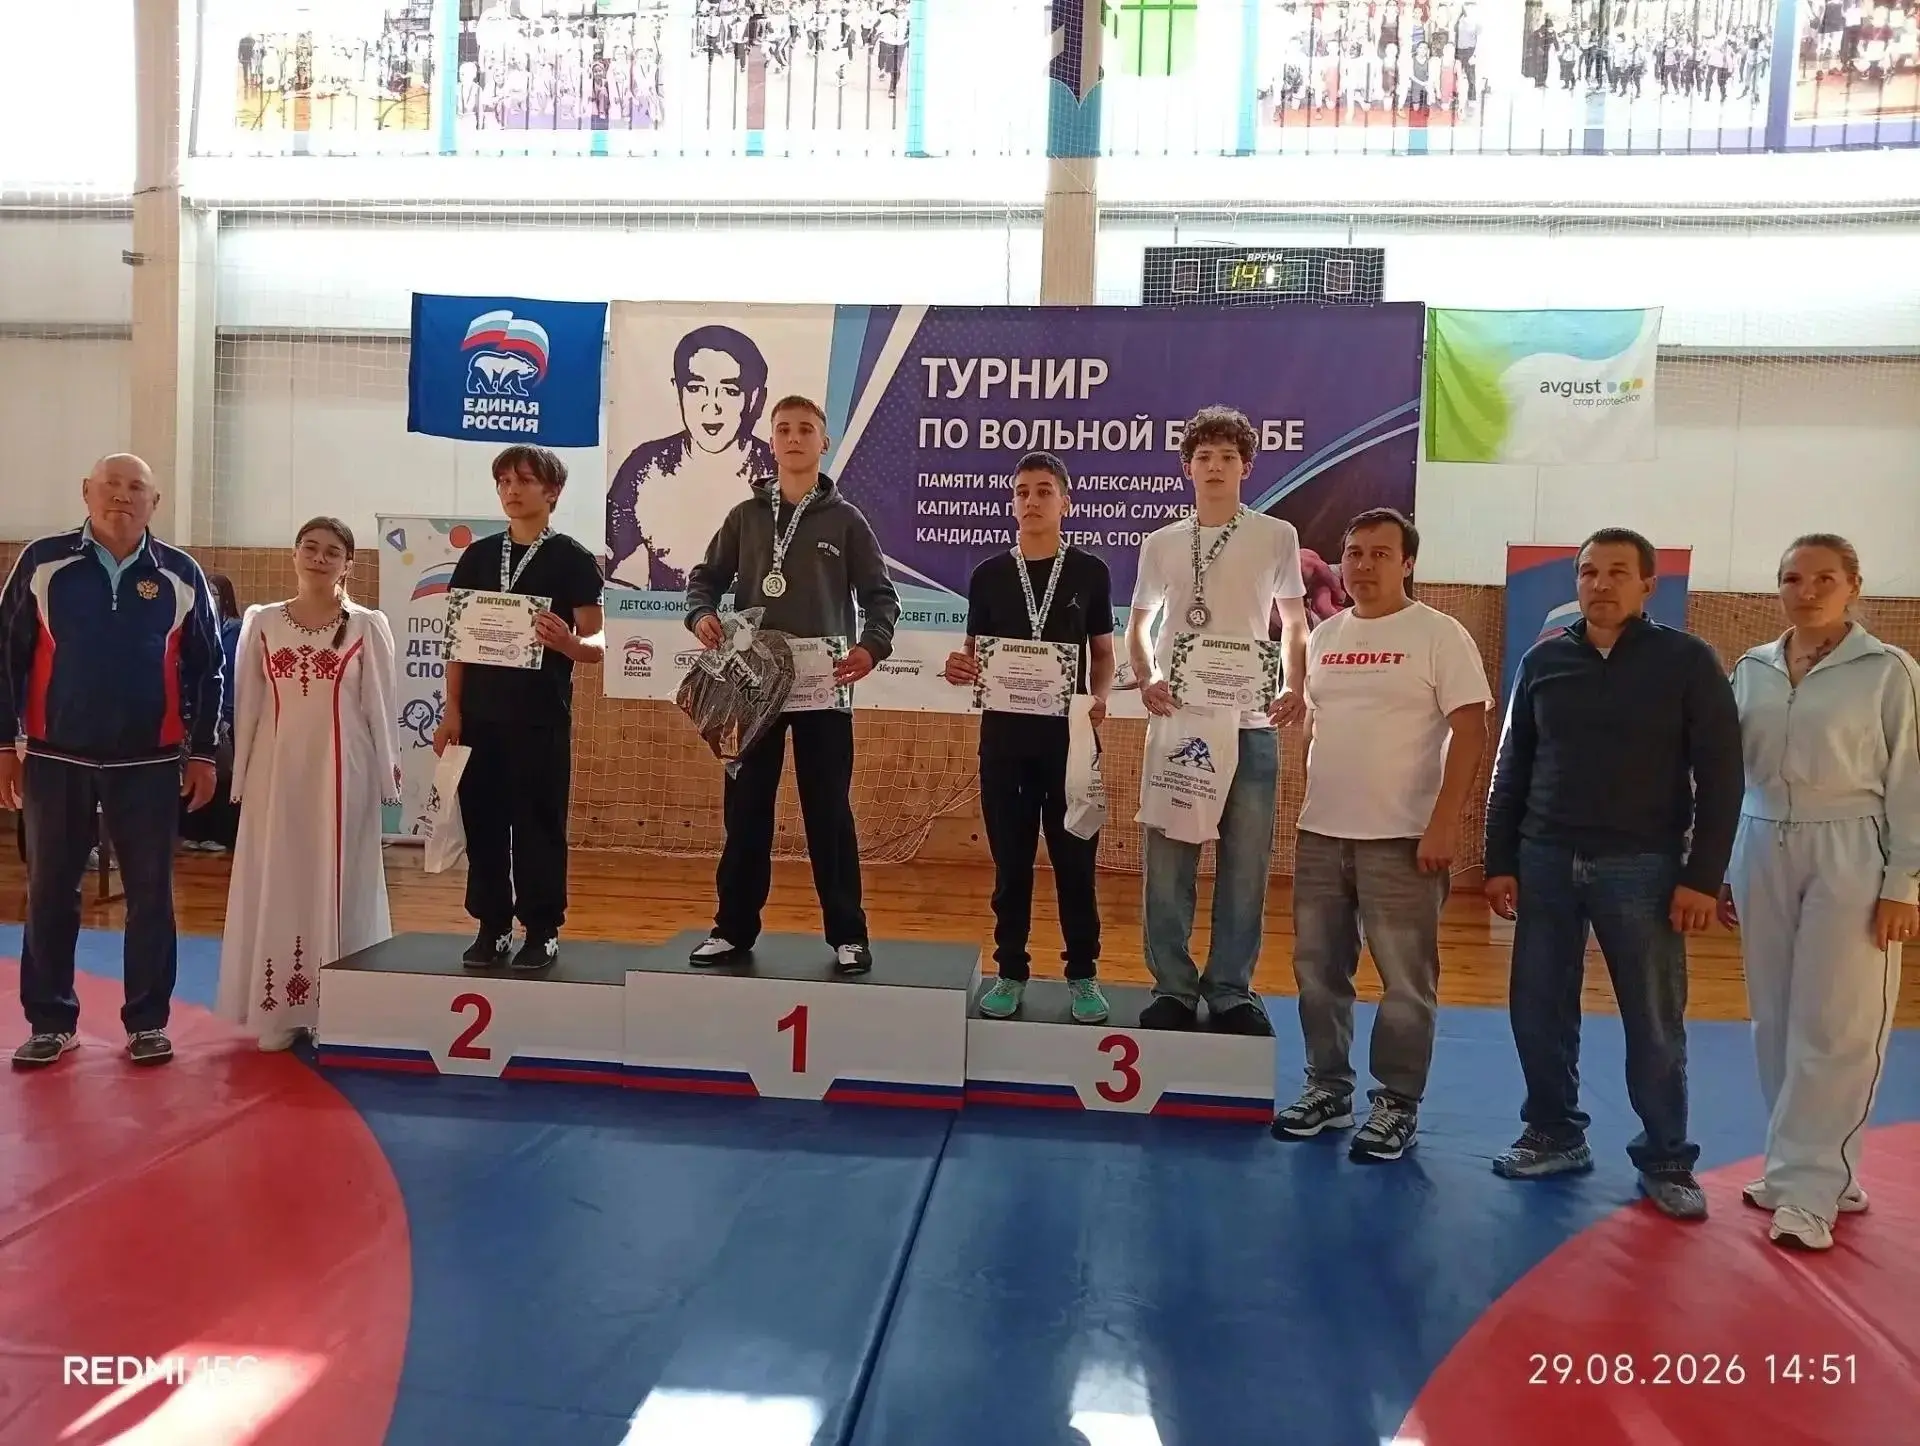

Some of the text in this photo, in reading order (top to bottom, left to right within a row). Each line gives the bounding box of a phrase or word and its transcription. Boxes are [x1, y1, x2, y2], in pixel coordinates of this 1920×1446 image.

[1247, 253, 1284, 262] ВРЕМЯ
[920, 357, 1109, 400] ТУРНИР
[1540, 379, 1602, 398] avgust
[463, 397, 540, 416] ЕДИНАЯ
[462, 414, 539, 434] РОССИЯ
[919, 418, 969, 449] ПО
[979, 413, 1153, 452] ВОЛЬНОЙ
[918, 473, 984, 489] ПАМЯТИ
[1077, 475, 1184, 493] АЛЕКСАНДРА
[917, 500, 1001, 517] КАПИТАНА
[916, 527, 1012, 546] КАНДИДАТА
[476, 595, 521, 608] ДИПЛОМ
[408, 617, 444, 634] ПРО
[406, 639, 443, 657] ДЕТ
[1002, 643, 1049, 656] ДИПЛОМ
[1202, 639, 1251, 652] ДИПЛОМ
[1321, 652, 1404, 665] SELSOVET
[406, 661, 445, 679] СПО
[448, 993, 492, 1060] 2
[777, 1005, 808, 1073] 1
[1095, 1034, 1142, 1103] 3
